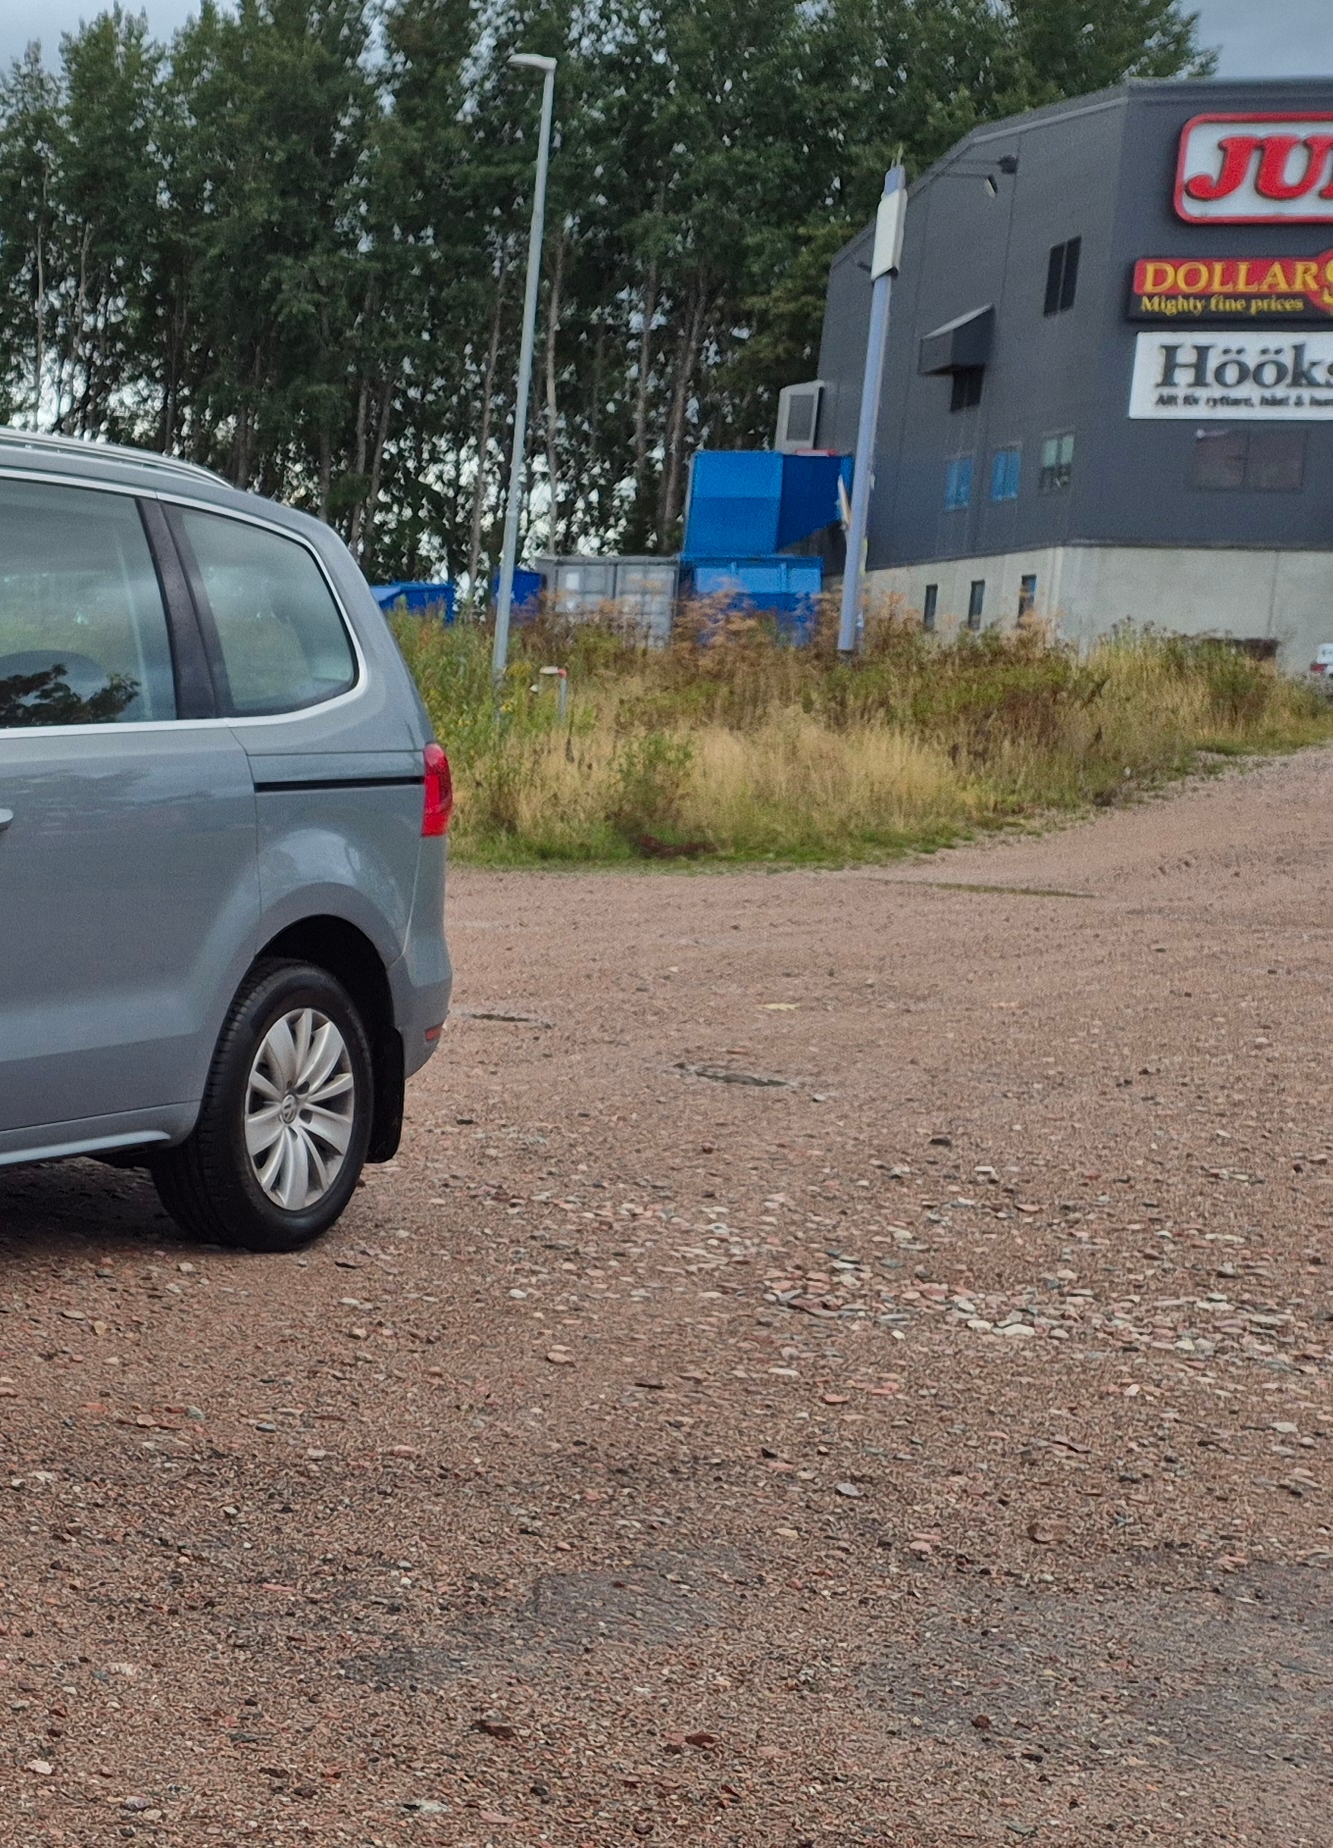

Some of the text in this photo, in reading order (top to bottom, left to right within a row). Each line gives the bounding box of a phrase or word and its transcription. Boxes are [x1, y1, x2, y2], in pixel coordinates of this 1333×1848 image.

[1186, 134, 1333, 201] JU
[1141, 294, 1304, 316] Mighty fine prices
